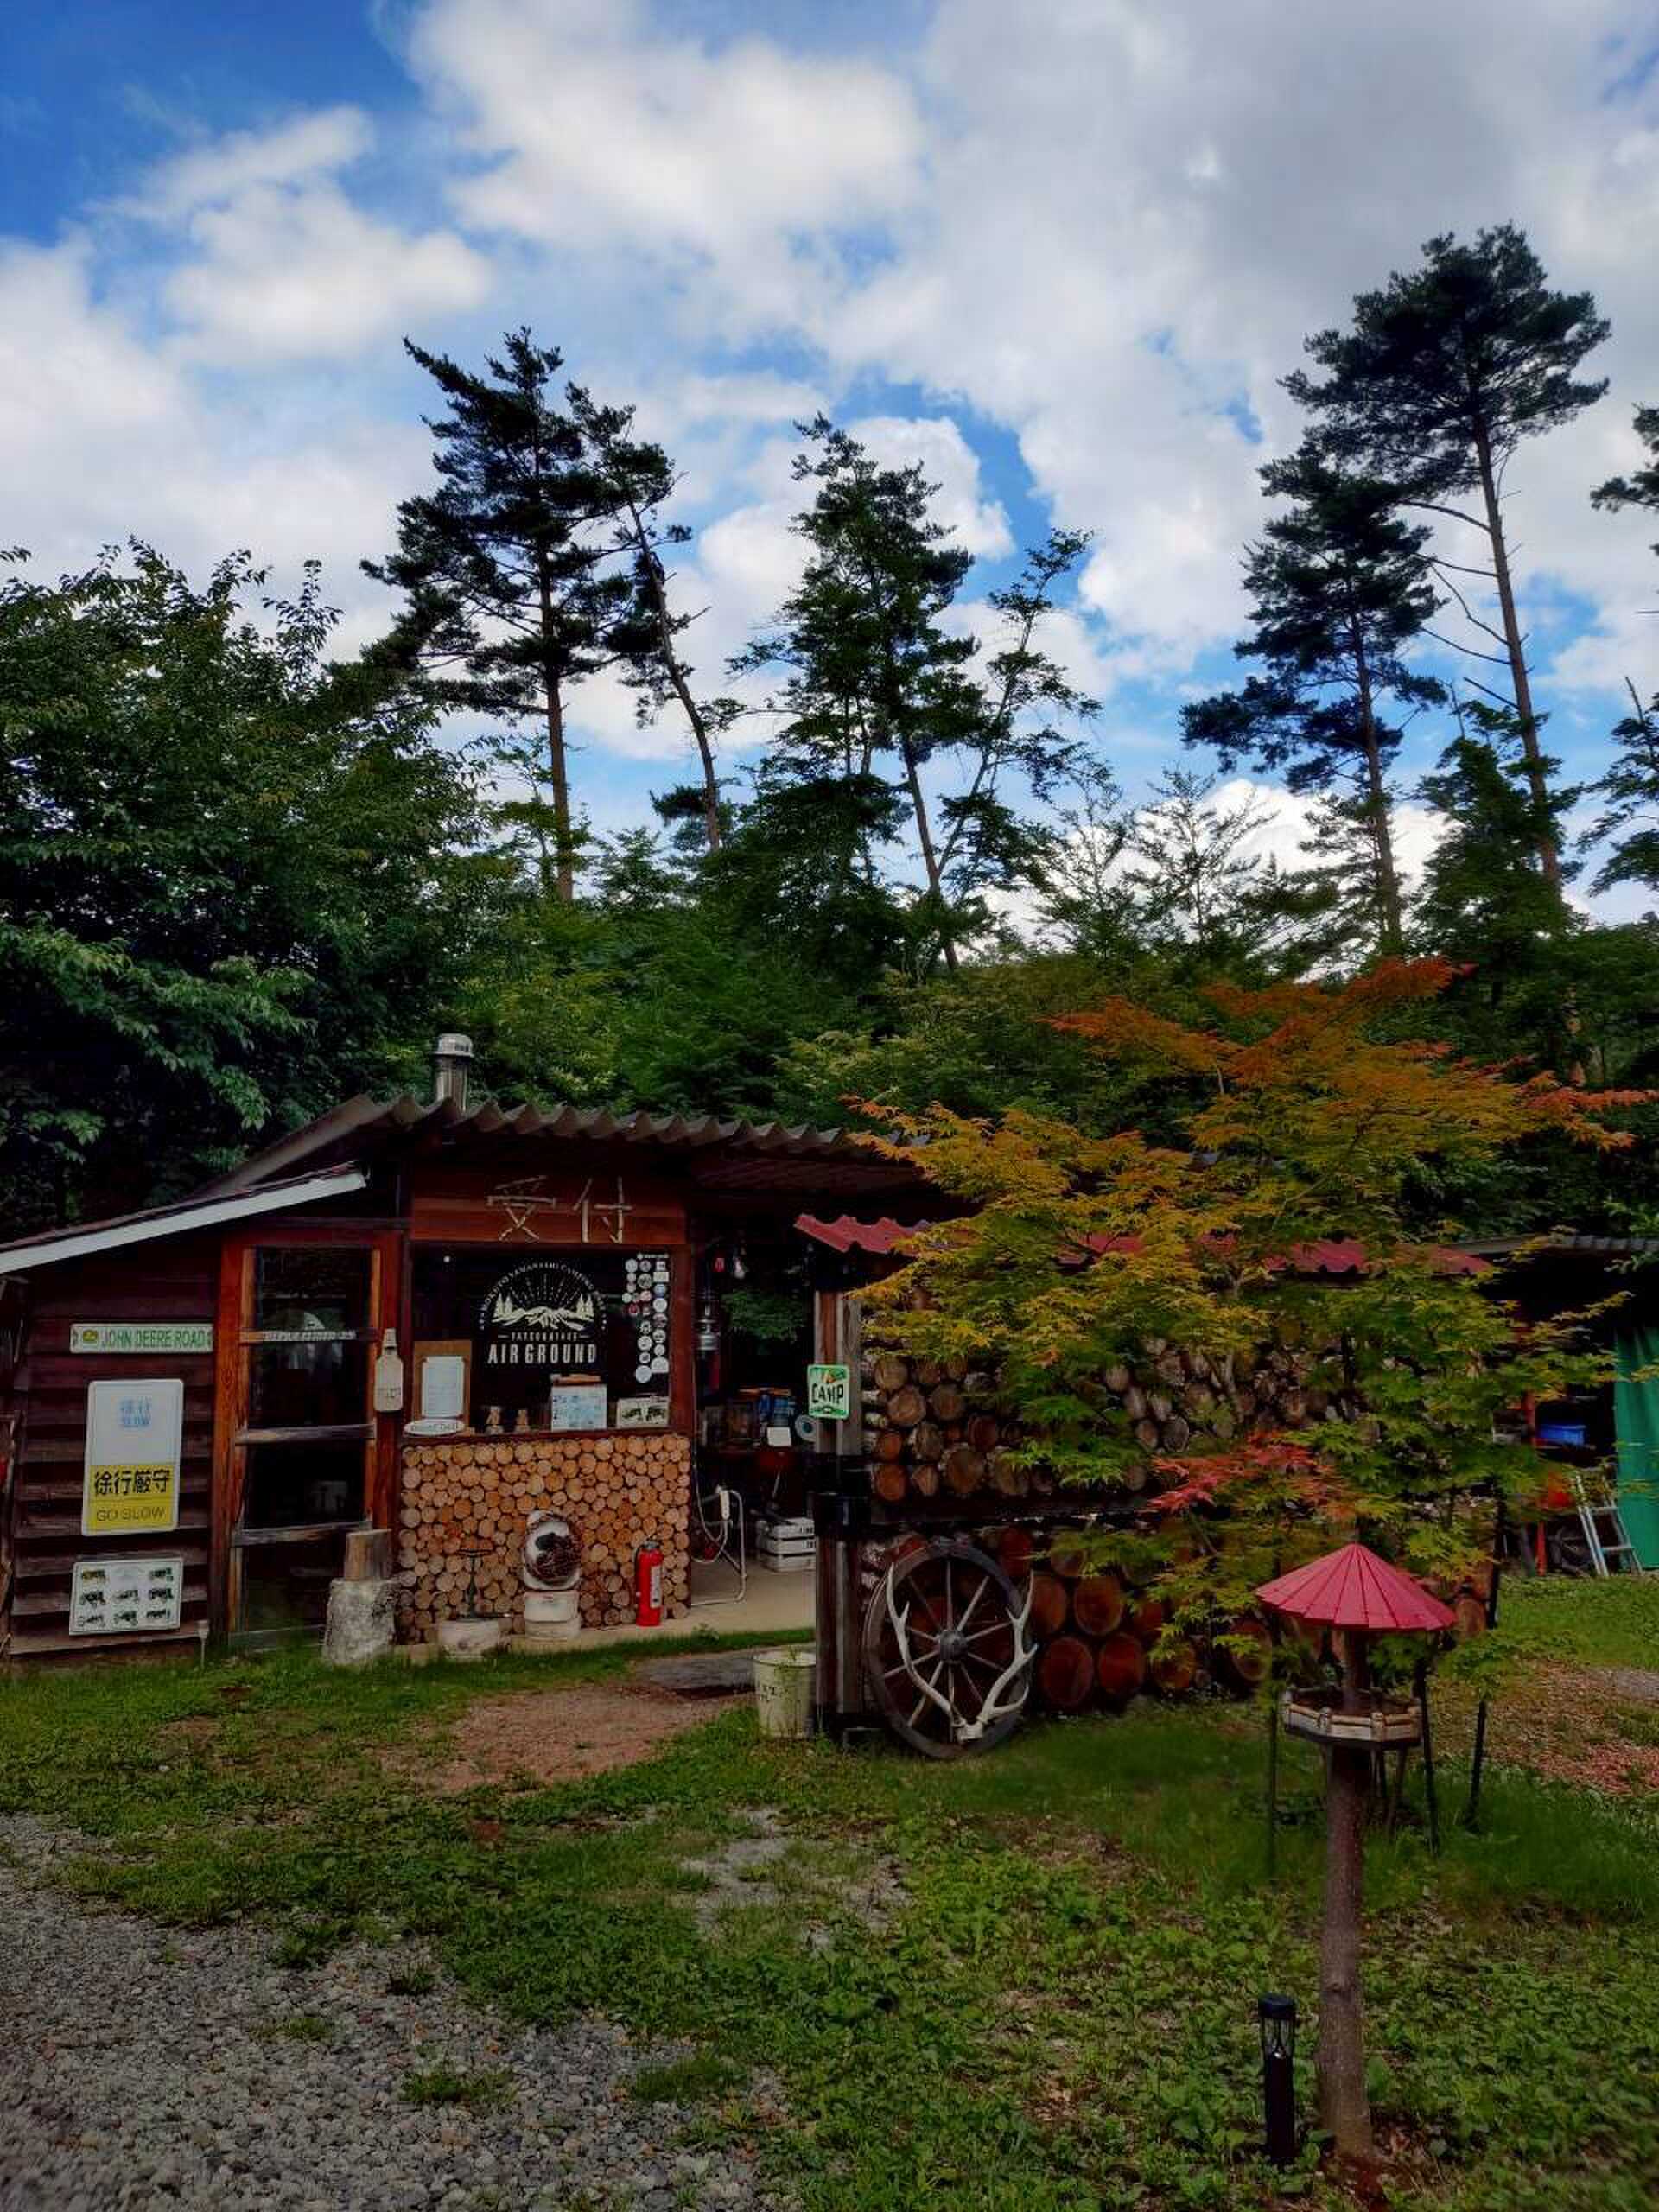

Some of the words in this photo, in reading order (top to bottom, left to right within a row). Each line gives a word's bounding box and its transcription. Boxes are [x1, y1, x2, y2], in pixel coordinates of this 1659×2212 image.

[486, 1174, 634, 1243] 受付
[101, 1329, 132, 1348] JOHN
[137, 1329, 173, 1348] DEERE
[175, 1329, 206, 1348] ROAD
[487, 1344, 519, 1364] AIR
[524, 1344, 596, 1364] GROUND
[812, 1382, 844, 1404] CAMP
[94, 1469, 170, 1496] 徐行厳守
[97, 1507, 118, 1522] GO
[123, 1506, 167, 1522] SLOW
